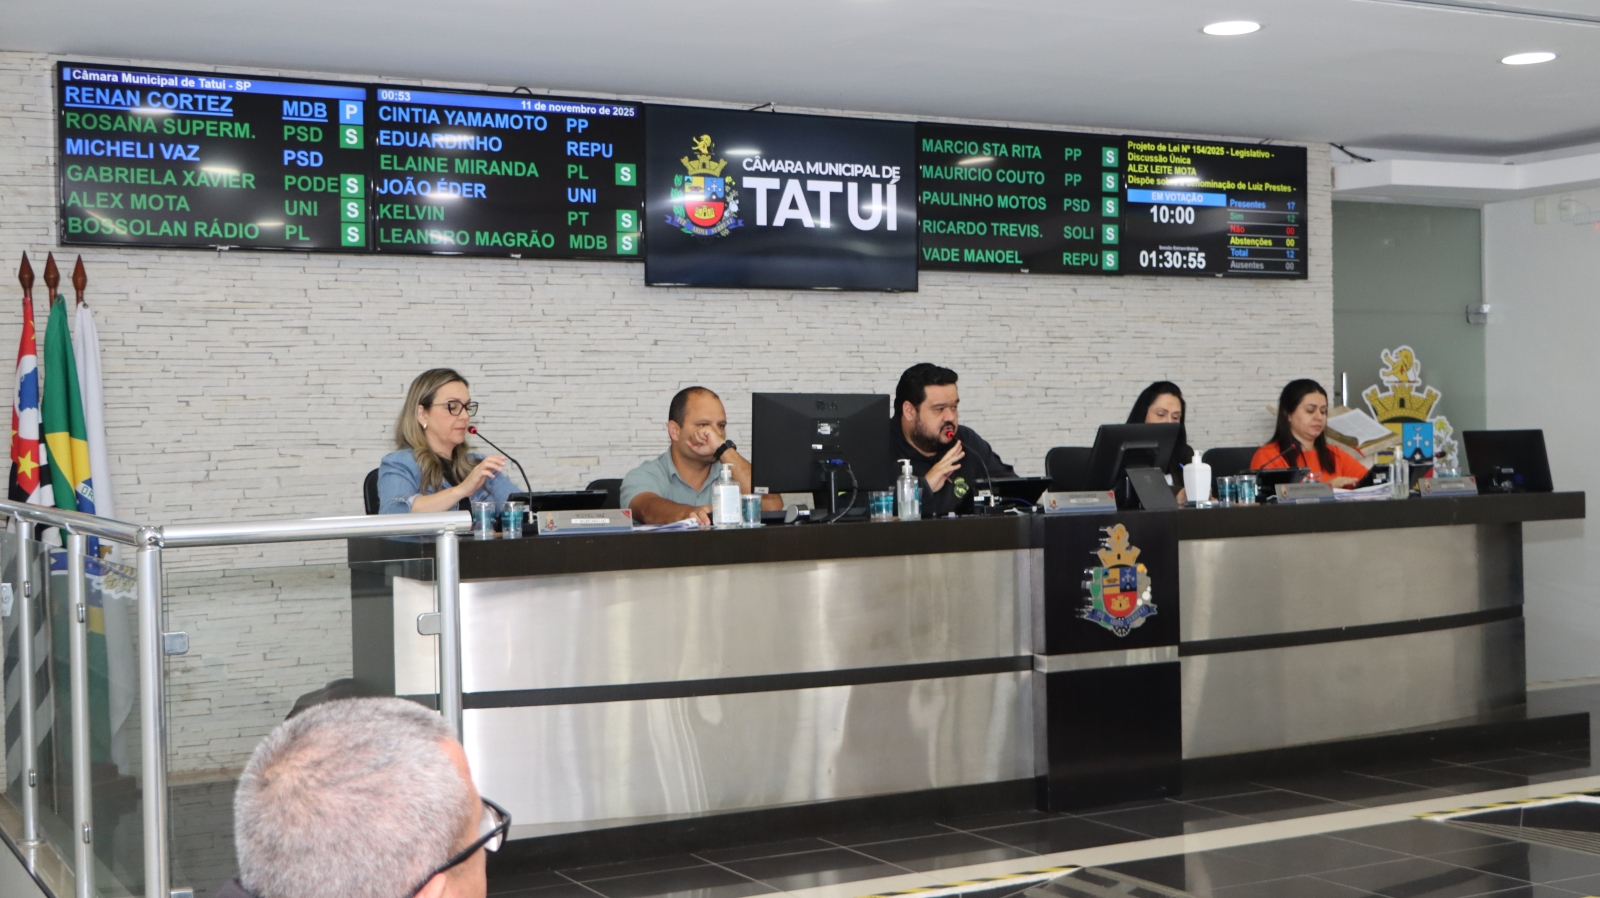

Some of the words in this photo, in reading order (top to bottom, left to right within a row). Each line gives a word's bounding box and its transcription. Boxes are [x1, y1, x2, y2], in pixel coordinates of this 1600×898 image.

[72, 70, 118, 82] Câmara
[122, 73, 178, 88] Municipal
[181, 76, 195, 87] de
[236, 80, 252, 90] SP
[65, 86, 140, 106] RENAN
[147, 91, 233, 112] CORTEZ
[282, 100, 328, 118] MDB
[346, 104, 358, 120] P
[382, 90, 411, 101] 00:53
[522, 100, 532, 110] 11
[534, 102, 546, 112] de
[548, 103, 596, 114] novembro
[599, 106, 610, 116] de
[612, 106, 634, 117] 2025
[66, 112, 158, 134] ROSANA
[163, 118, 256, 140] SUPERM.
[283, 125, 323, 142] PSD
[346, 129, 358, 145] S
[378, 106, 440, 125] CINTIA
[444, 110, 548, 132] YAMAMOTO
[566, 118, 588, 134] PP
[66, 138, 154, 159] MICHELI
[160, 143, 200, 162] VAZ
[283, 150, 323, 168] PSD
[379, 130, 502, 152] EDUARDINHO
[566, 142, 613, 158] REPU
[922, 138, 978, 155] MARCIO
[982, 143, 1008, 157] STA
[1012, 145, 1042, 159] RITA
[1065, 148, 1082, 161] PP
[1106, 150, 1114, 164] S
[1128, 141, 1154, 152] Projeto
[1156, 143, 1166, 152] de
[1168, 144, 1180, 152] Lei
[1192, 146, 1224, 155] 154/2025
[1230, 148, 1270, 158] Legislativo
[380, 154, 448, 173] ELAINE
[454, 158, 539, 178] MIRANDA
[568, 164, 588, 180] PL
[620, 166, 632, 182] S
[742, 156, 804, 174] CÂMARA
[806, 162, 880, 178] MUNICIPAL
[882, 166, 900, 179] DE
[1128, 153, 1168, 164] Discussão
[1170, 154, 1191, 164] Única
[67, 165, 177, 186] GABRIELA
[182, 170, 256, 189] XAVIER
[284, 175, 339, 194] PODE
[346, 178, 358, 194] S
[922, 165, 992, 182] MAURICIO
[996, 169, 1044, 184] COUTO
[1065, 174, 1082, 186] PP
[1106, 176, 1114, 188] S
[1128, 164, 1149, 174] ALEX
[1151, 166, 1172, 174] LEITE
[1174, 166, 1196, 176] MOTA
[378, 176, 431, 196] JOÃO
[436, 180, 486, 198] ÉDER
[568, 188, 596, 204] UNI
[1128, 175, 1154, 186] Dispõe
[1186, 178, 1236, 190] denominação
[1248, 182, 1262, 191] Luiz
[1264, 184, 1291, 192] Prestes
[67, 191, 124, 209] ALEX
[130, 193, 190, 212] MOTA
[285, 200, 318, 216] UNI
[346, 202, 359, 218] S
[742, 177, 900, 231] TATUÍ
[922, 192, 993, 208] PAULINHO
[998, 196, 1046, 210] MOTOS
[1064, 198, 1090, 212] PSD
[1106, 200, 1114, 214] S
[1152, 192, 1164, 200] EM
[1165, 192, 1204, 204] VOTAÇÃO
[1230, 199, 1266, 209] Presentes
[1287, 202, 1296, 210] 17
[380, 204, 444, 220] KELVIN
[568, 212, 589, 226] PT
[621, 214, 632, 228] S
[1150, 205, 1195, 224] 10:00
[1230, 212, 1244, 220] Sim
[1287, 214, 1296, 222] 12
[68, 216, 188, 237] BOSSOLAN
[194, 218, 260, 239] RÁDIO
[285, 224, 310, 241] PL
[347, 226, 360, 242] S
[380, 228, 470, 246] LEANDRO
[476, 230, 554, 248] MAGRÃO
[570, 234, 608, 250] MDB
[621, 236, 632, 250] S
[923, 220, 986, 235] RICARDO
[991, 222, 1043, 238] TREVIS.
[1064, 226, 1094, 240] SOLI
[1106, 228, 1114, 240] S
[1230, 224, 1245, 234] Não
[1286, 227, 1294, 235] 00
[1230, 236, 1272, 247] Abstenções
[1286, 238, 1294, 247] 00
[922, 248, 960, 262] VADE
[964, 249, 1022, 264] MANOEL
[1063, 252, 1098, 266] REPU
[1106, 254, 1114, 267] S
[1140, 250, 1206, 269] 01:30:55
[1230, 248, 1248, 257] Total
[1286, 250, 1294, 258] 12
[1230, 260, 1264, 270] Ausentes
